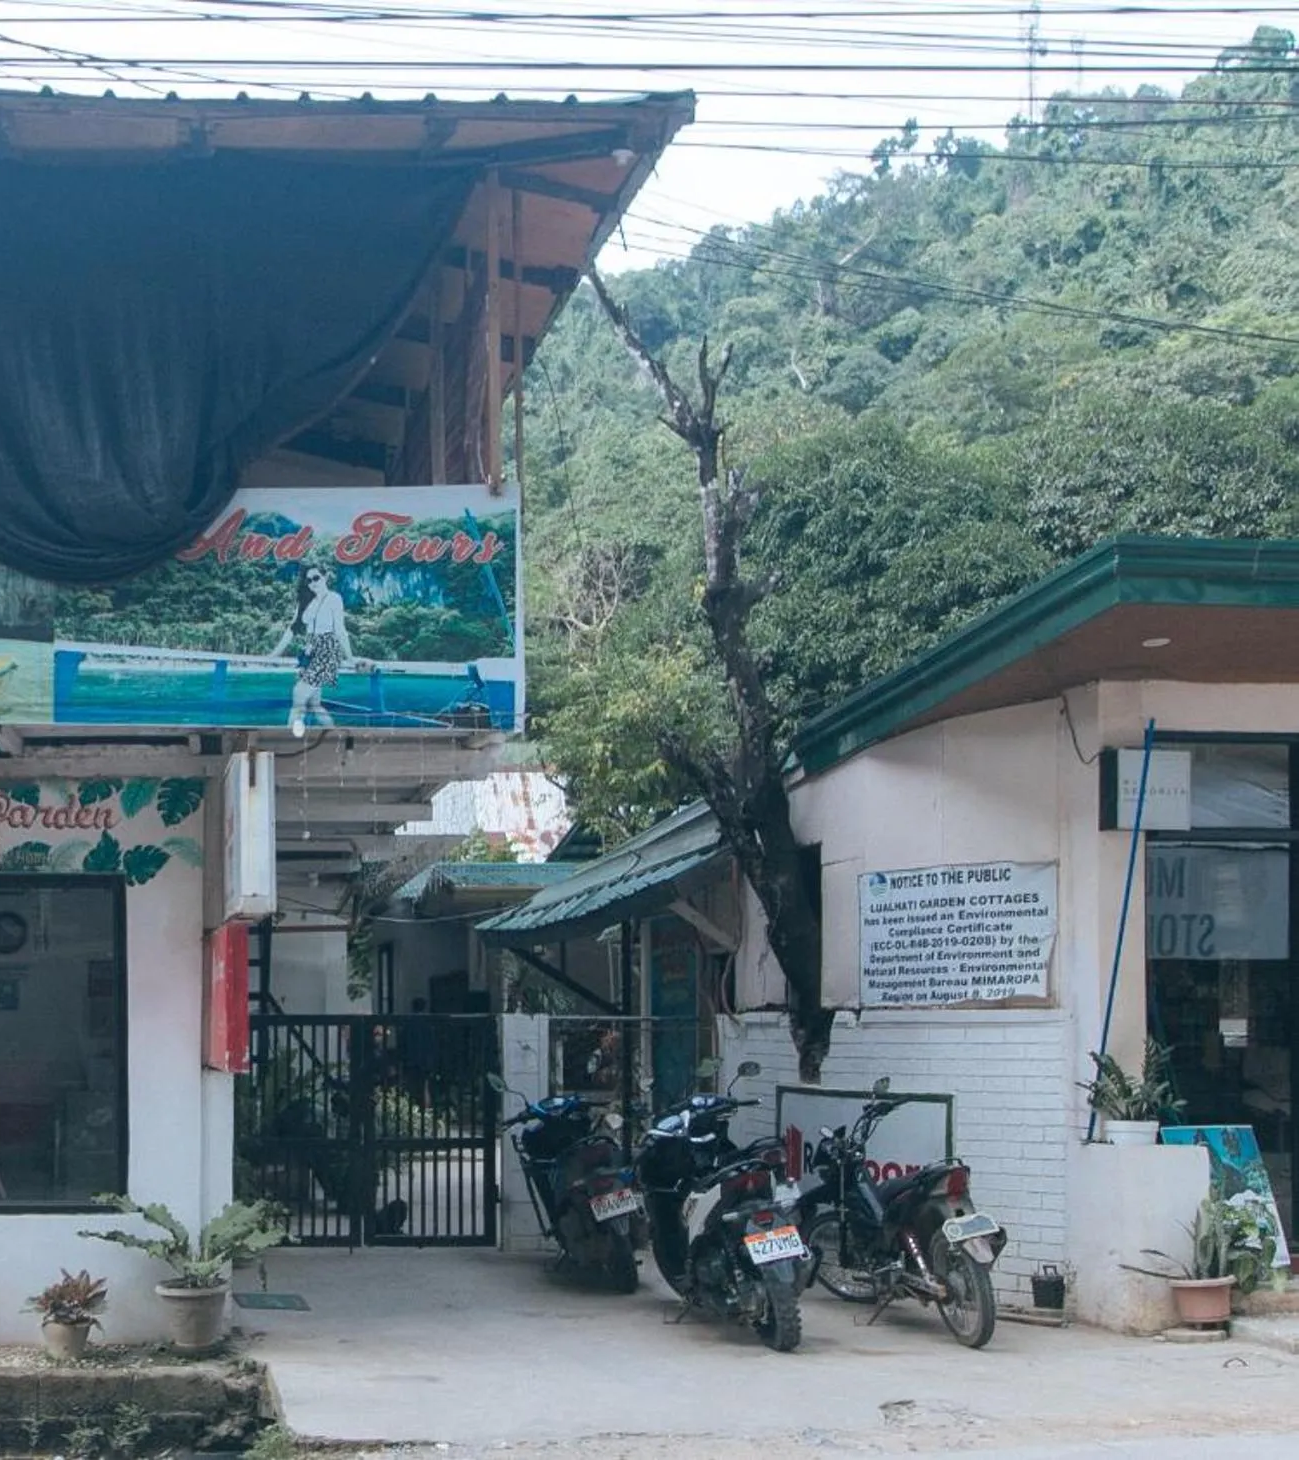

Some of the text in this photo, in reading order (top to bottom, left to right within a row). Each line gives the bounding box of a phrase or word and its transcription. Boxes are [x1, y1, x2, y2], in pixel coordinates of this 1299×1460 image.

[177, 507, 508, 565] And Tours
[890, 868, 1011, 889] NOTICE TO THE PUBLIC
[870, 893, 1039, 913] LUALHATI GARDEN COTTAGES
[864, 906, 1049, 926] has been issued an Environmental
[888, 922, 1013, 938] Compliance Certificate
[1000, 936, 1014, 946] by
[1018, 934, 1039, 945] the
[869, 947, 1040, 965] Department of Environment and
[864, 966, 896, 977] Natural
[898, 965, 949, 975] Resources
[868, 973, 1041, 990] Management Bureau MIMAROPA
[930, 990, 968, 1001] August
